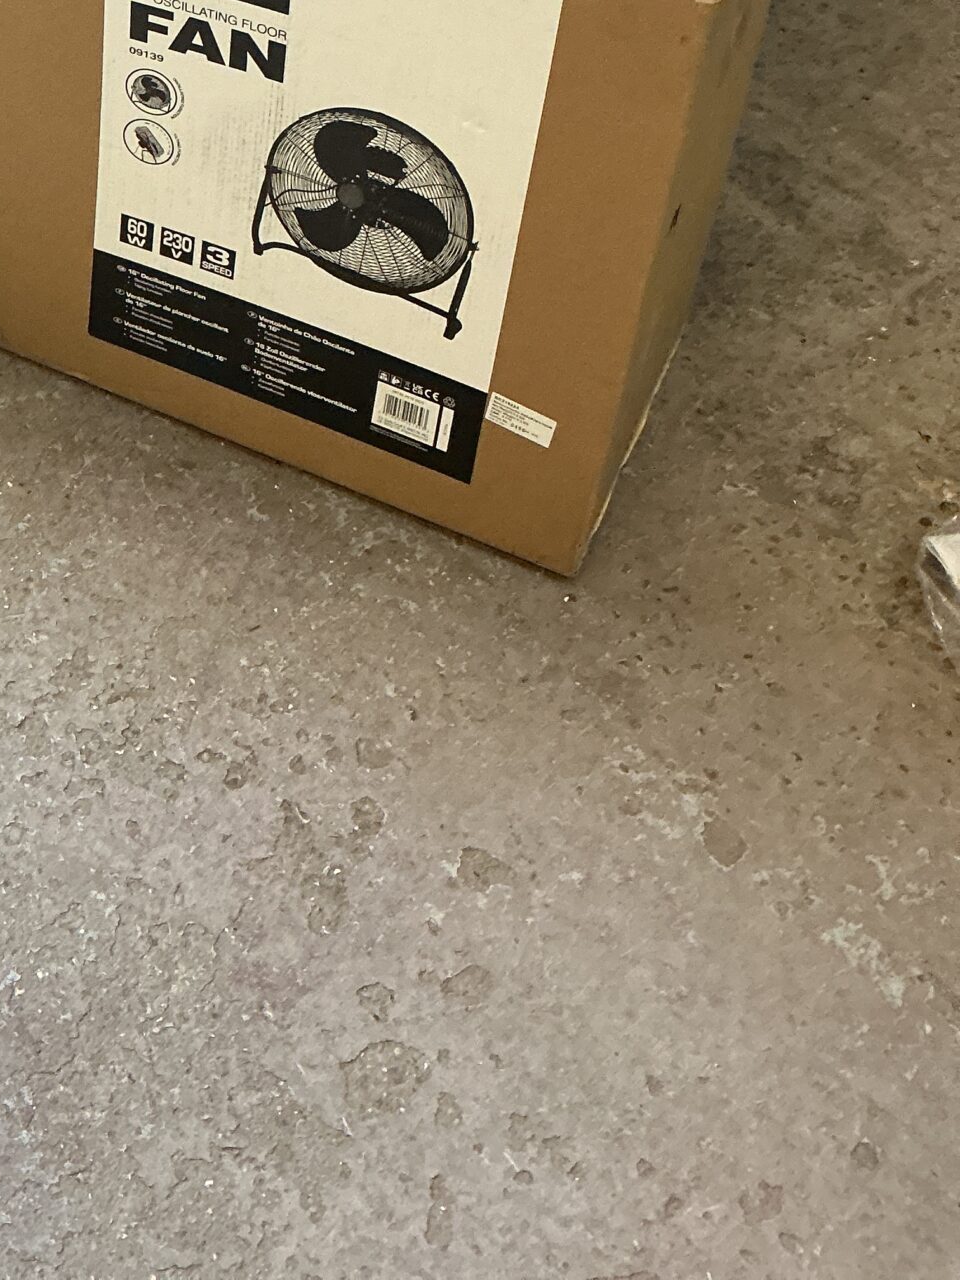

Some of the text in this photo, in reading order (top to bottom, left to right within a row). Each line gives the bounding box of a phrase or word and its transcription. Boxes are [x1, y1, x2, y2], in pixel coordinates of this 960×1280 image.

[241, 18, 288, 41] FLOOR
[129, 0, 288, 84] FAN
[129, 47, 164, 62] 09139
[127, 218, 148, 238] 60
[126, 233, 146, 247] W
[163, 230, 193, 253] 230
[171, 248, 183, 259] V
[206, 246, 230, 266] 3
[201, 260, 232, 277] SPEED
[140, 273, 175, 290] Oscillating
[175, 285, 193, 295] Floor
[193, 291, 206, 300] Fan
